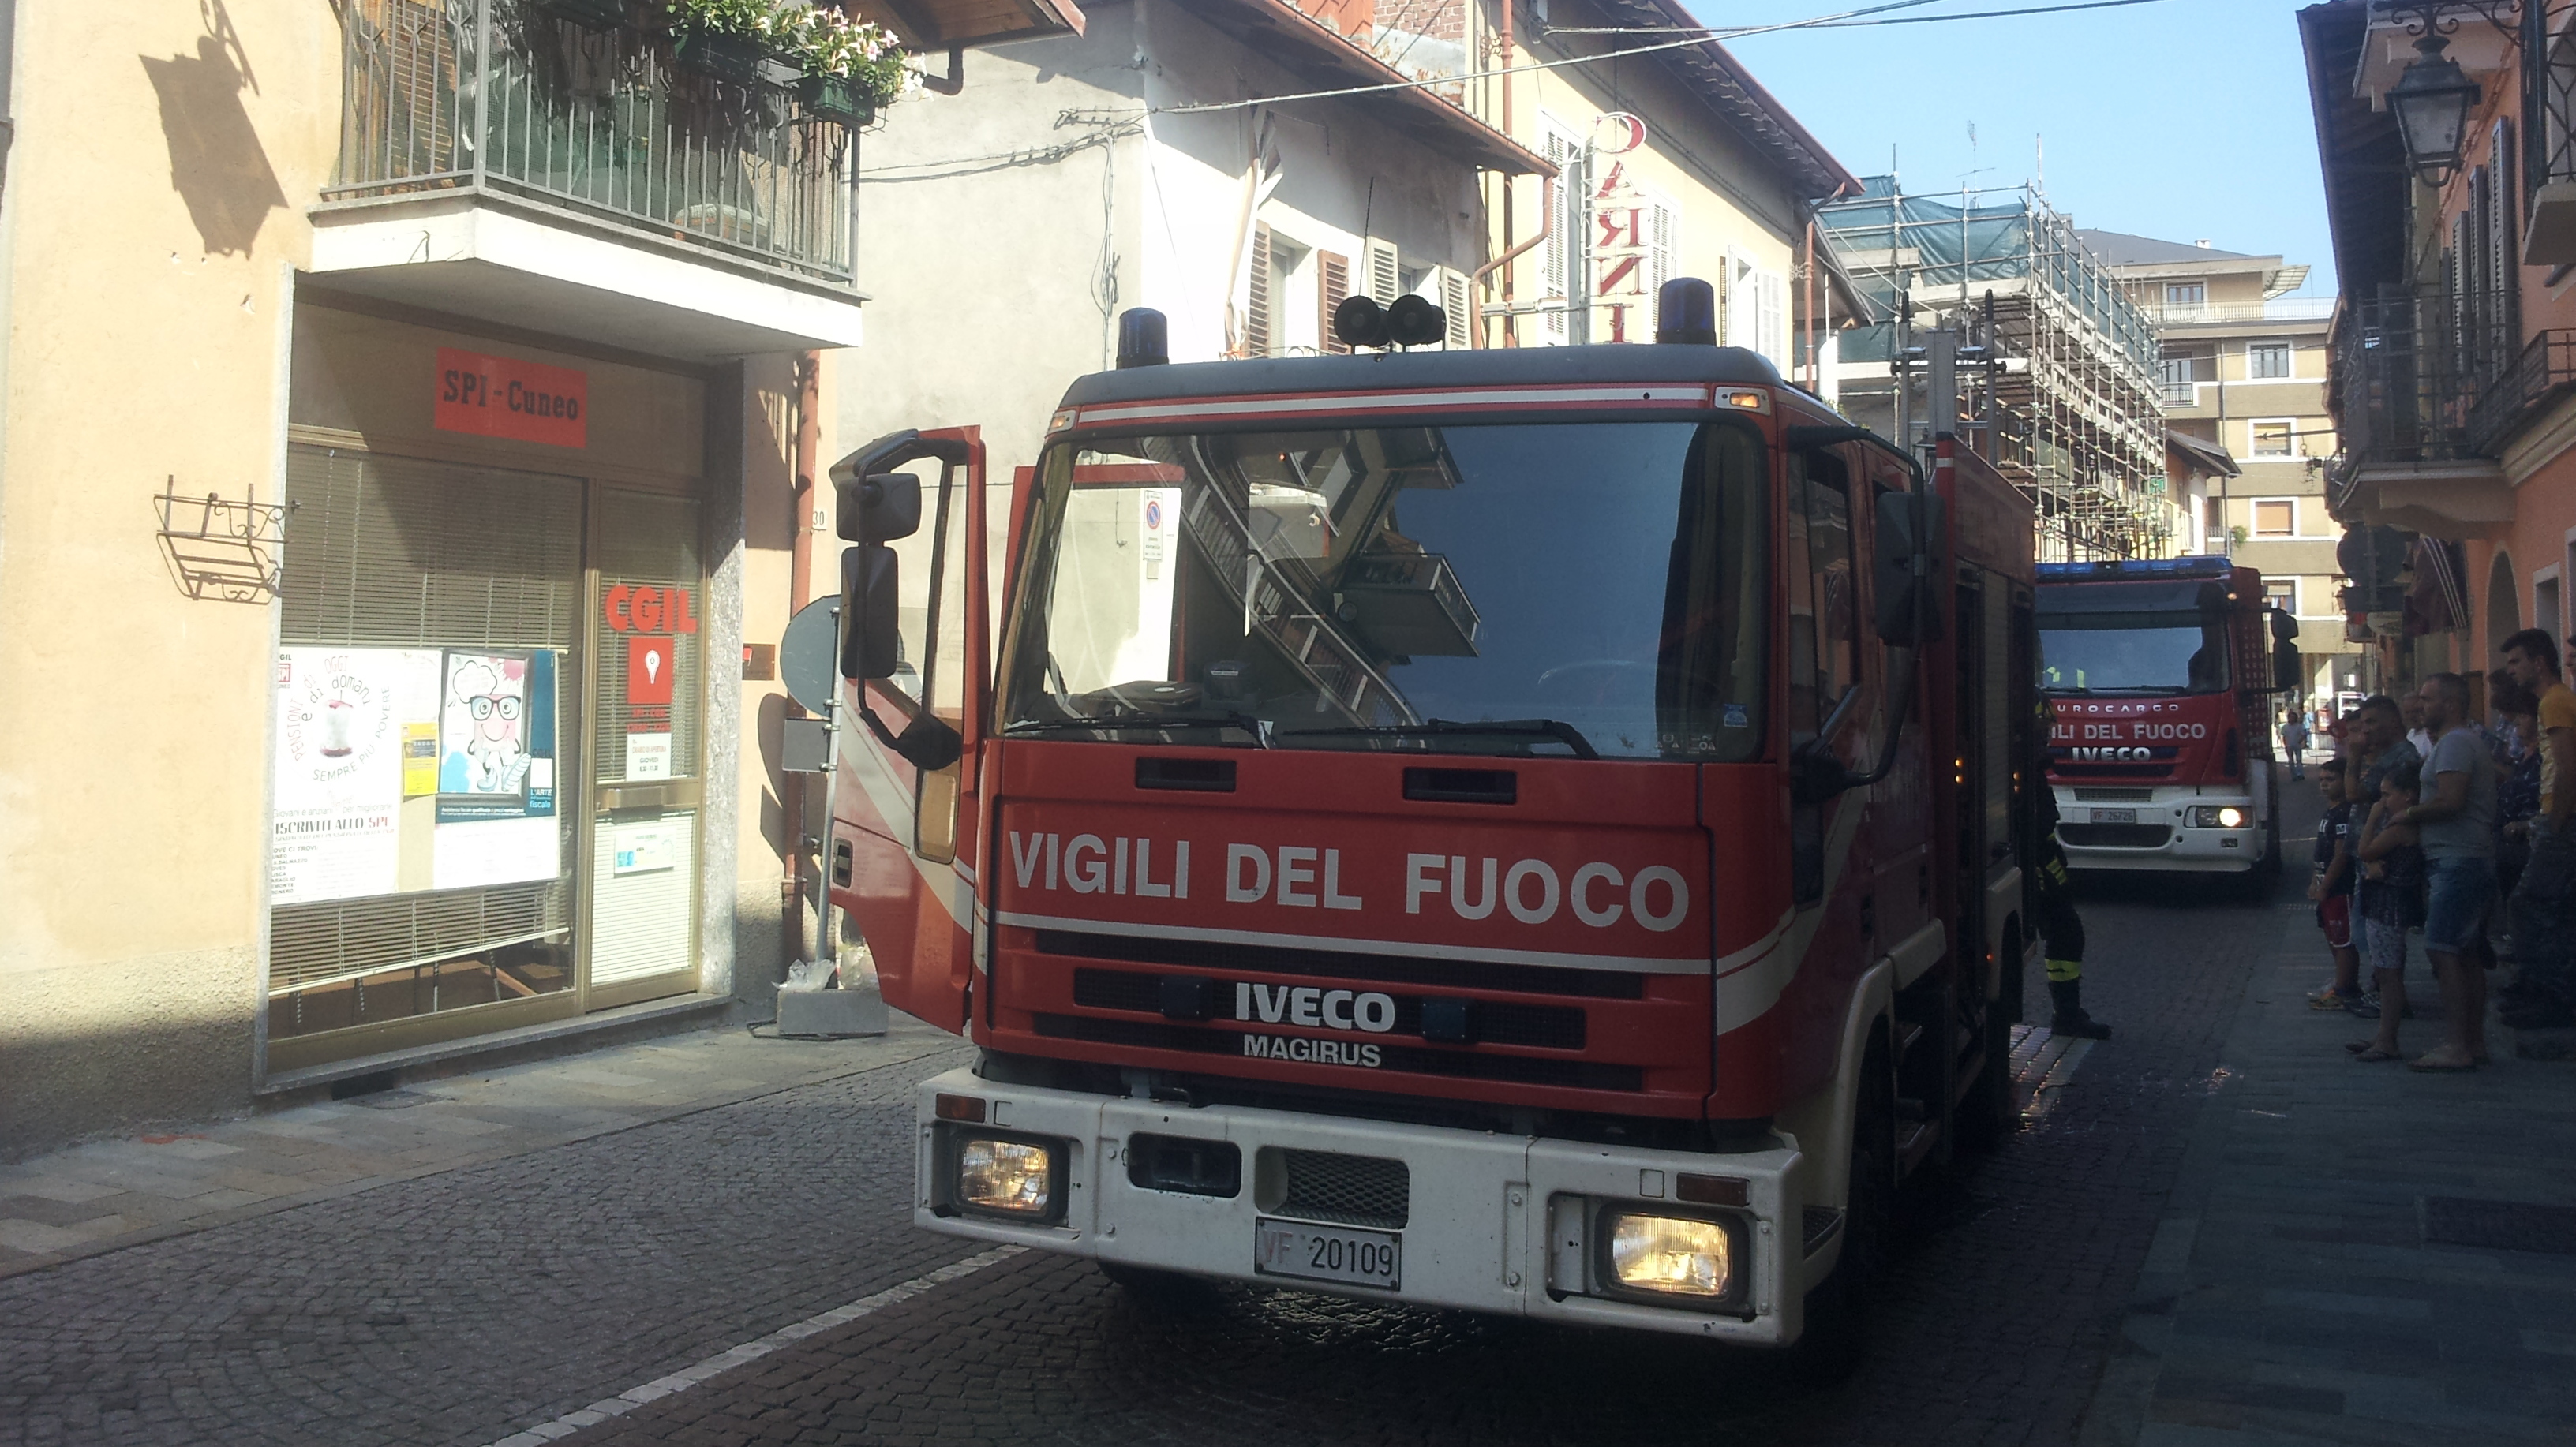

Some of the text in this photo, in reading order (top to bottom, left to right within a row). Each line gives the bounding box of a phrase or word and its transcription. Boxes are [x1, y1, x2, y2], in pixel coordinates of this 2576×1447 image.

[444, 369, 488, 407] SPI
[508, 380, 579, 421] Cuneo
[605, 584, 698, 634] CGIL
[324, 655, 349, 674] OGGI
[331, 675, 371, 706] domani
[2057, 703, 2180, 713] UROCARGO
[312, 761, 358, 782] SEMPRE
[375, 686, 391, 739] POVERE
[2084, 724, 2123, 740] DEL
[2133, 723, 2207, 740] FUOCO
[2072, 746, 2151, 761] IVECO
[530, 799, 551, 808] fiscale
[275, 816, 388, 835] ISCRIVITI ALLO SPI
[1009, 831, 1690, 933] VIGILI DEL FUOCO
[1235, 981, 1396, 1033] IVECO
[1243, 1034, 1382, 1068] MAGIRUS
[1260, 1229, 1394, 1277] VF 20109
